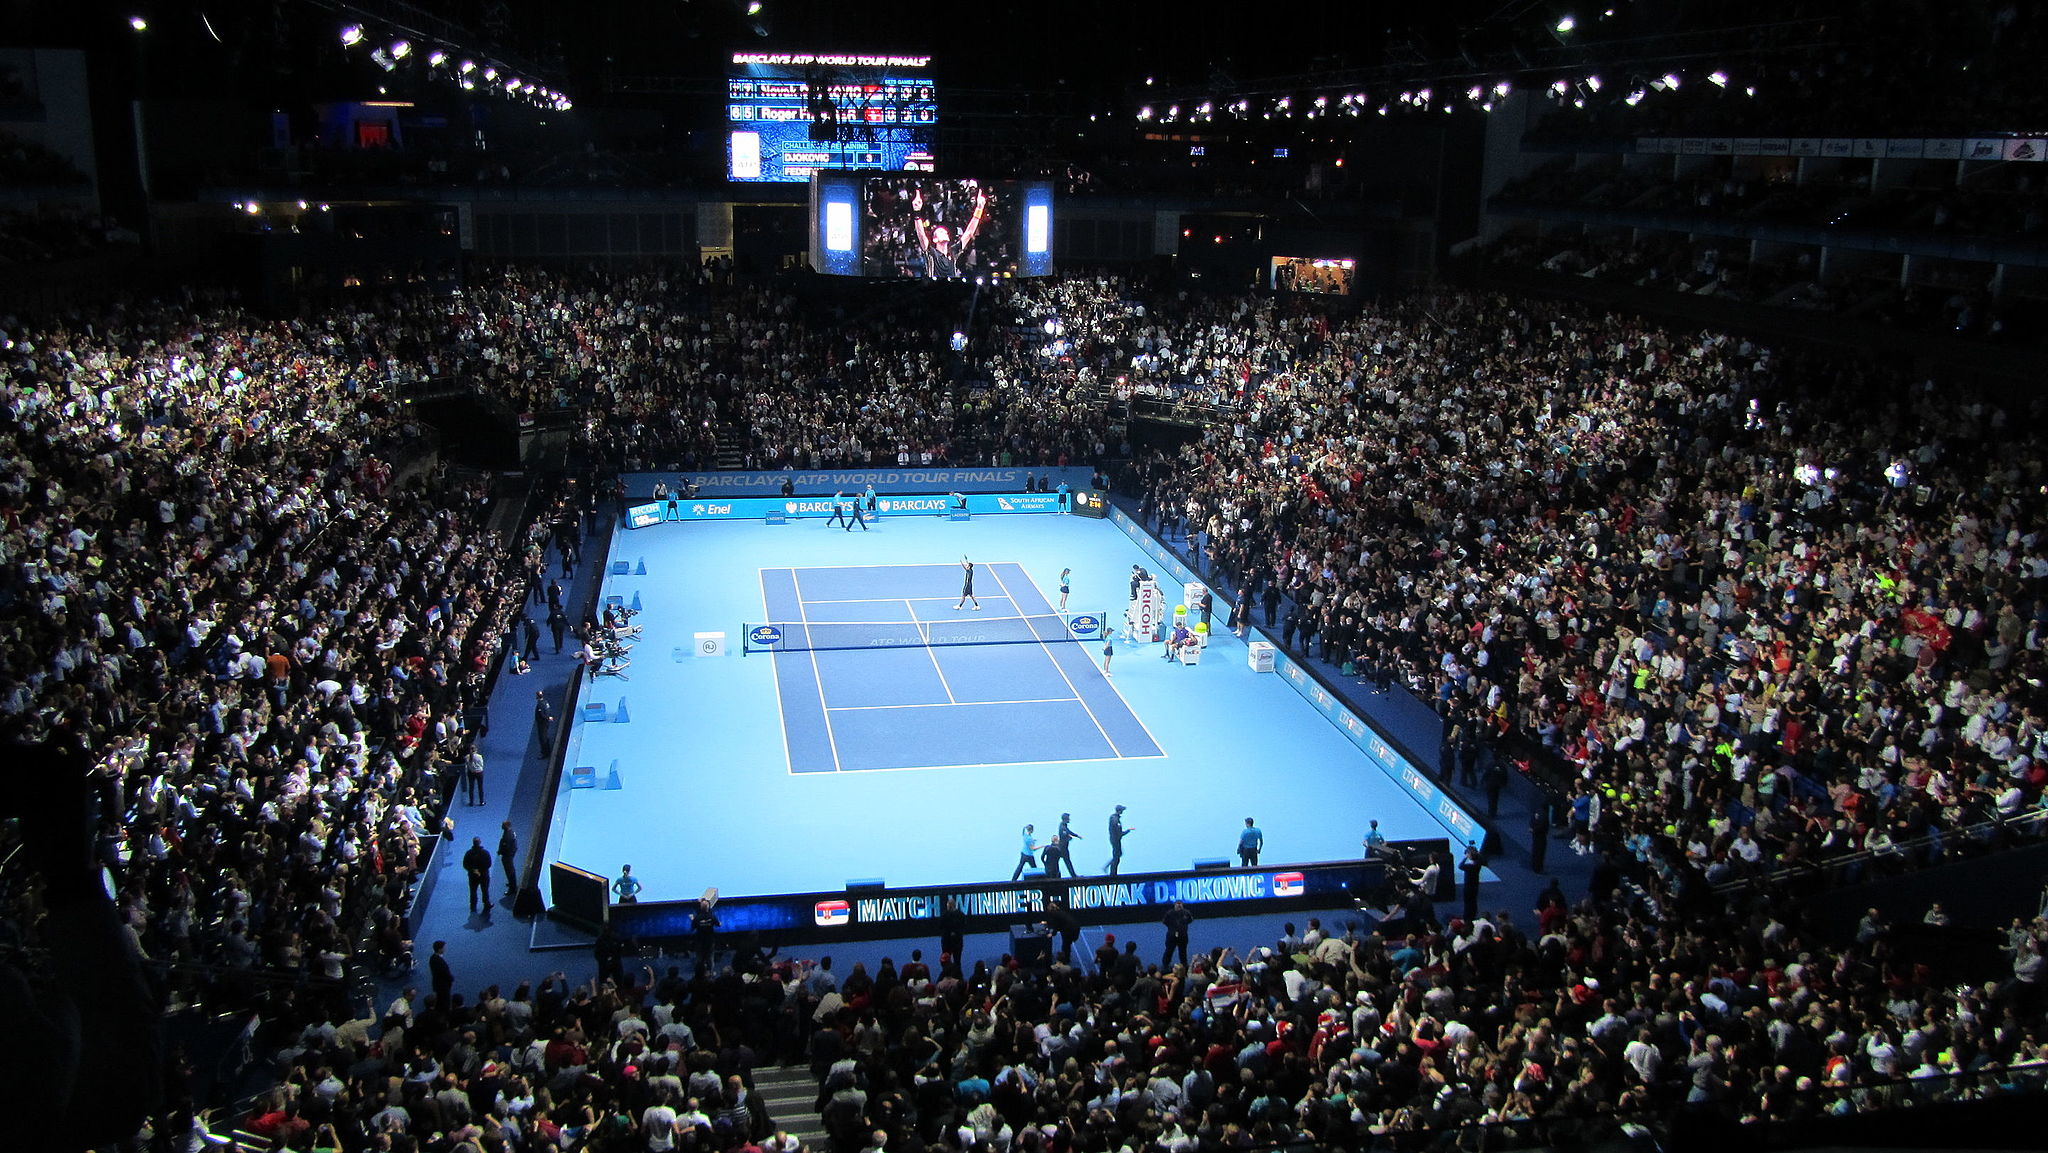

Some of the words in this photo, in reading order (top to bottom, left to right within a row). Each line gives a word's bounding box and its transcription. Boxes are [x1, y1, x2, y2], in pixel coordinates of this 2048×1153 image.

[732, 54, 791, 65] BARCLAYS
[791, 55, 815, 65] ATP
[816, 56, 859, 66] WORLD
[858, 57, 887, 66] TOUR
[887, 57, 926, 67] FINALS
[761, 108, 797, 122] Roger
[784, 153, 830, 162] DJOKOVIC
[694, 475, 794, 487] BARCLAYS
[794, 474, 831, 486] ATP
[833, 473, 900, 485] WORLD
[904, 472, 950, 483] TOUR
[953, 471, 1016, 482] FINALS
[632, 504, 659, 515] RICOH
[707, 504, 731, 515] Enel
[892, 499, 946, 511] BARCLAYS
[1141, 589, 1152, 635] RICOH
[1071, 622, 1098, 630] Corona
[751, 632, 780, 641] Corona
[857, 896, 941, 922] MATCH
[947, 889, 1044, 917] WINNER
[1069, 882, 1147, 909] NOVAK
[1154, 875, 1266, 904] DJOKOVIC
